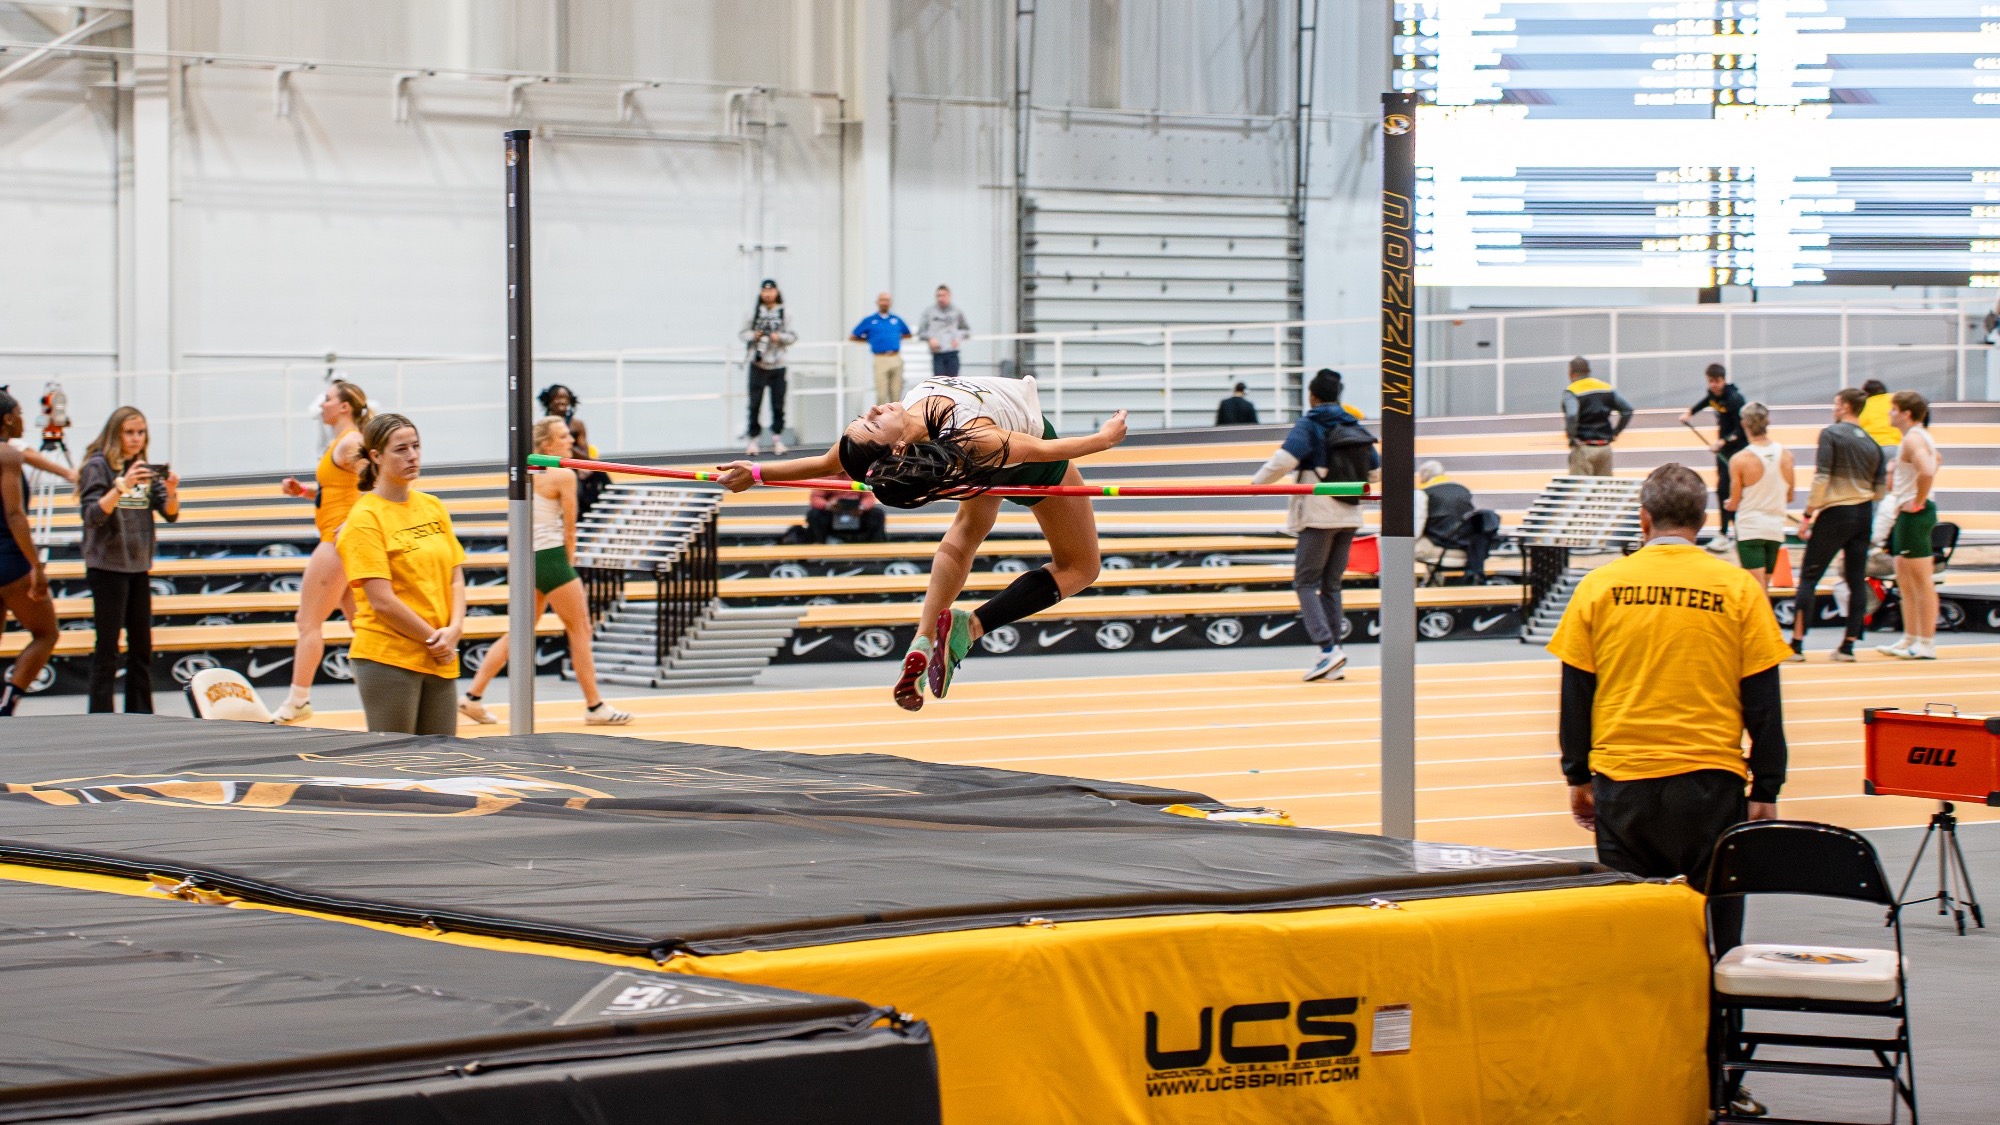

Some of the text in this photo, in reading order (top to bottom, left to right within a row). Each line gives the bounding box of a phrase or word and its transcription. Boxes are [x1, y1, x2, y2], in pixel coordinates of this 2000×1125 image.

[1716, 268, 1731, 285] 7
[1382, 190, 1412, 415] MIZZOU
[1611, 585, 1725, 613] VOLUNTEER
[1907, 746, 1957, 767] GILL
[1145, 997, 1358, 1070] UCS
[1146, 1066, 1360, 1098] WWW.UCSSPIRIT.COM
